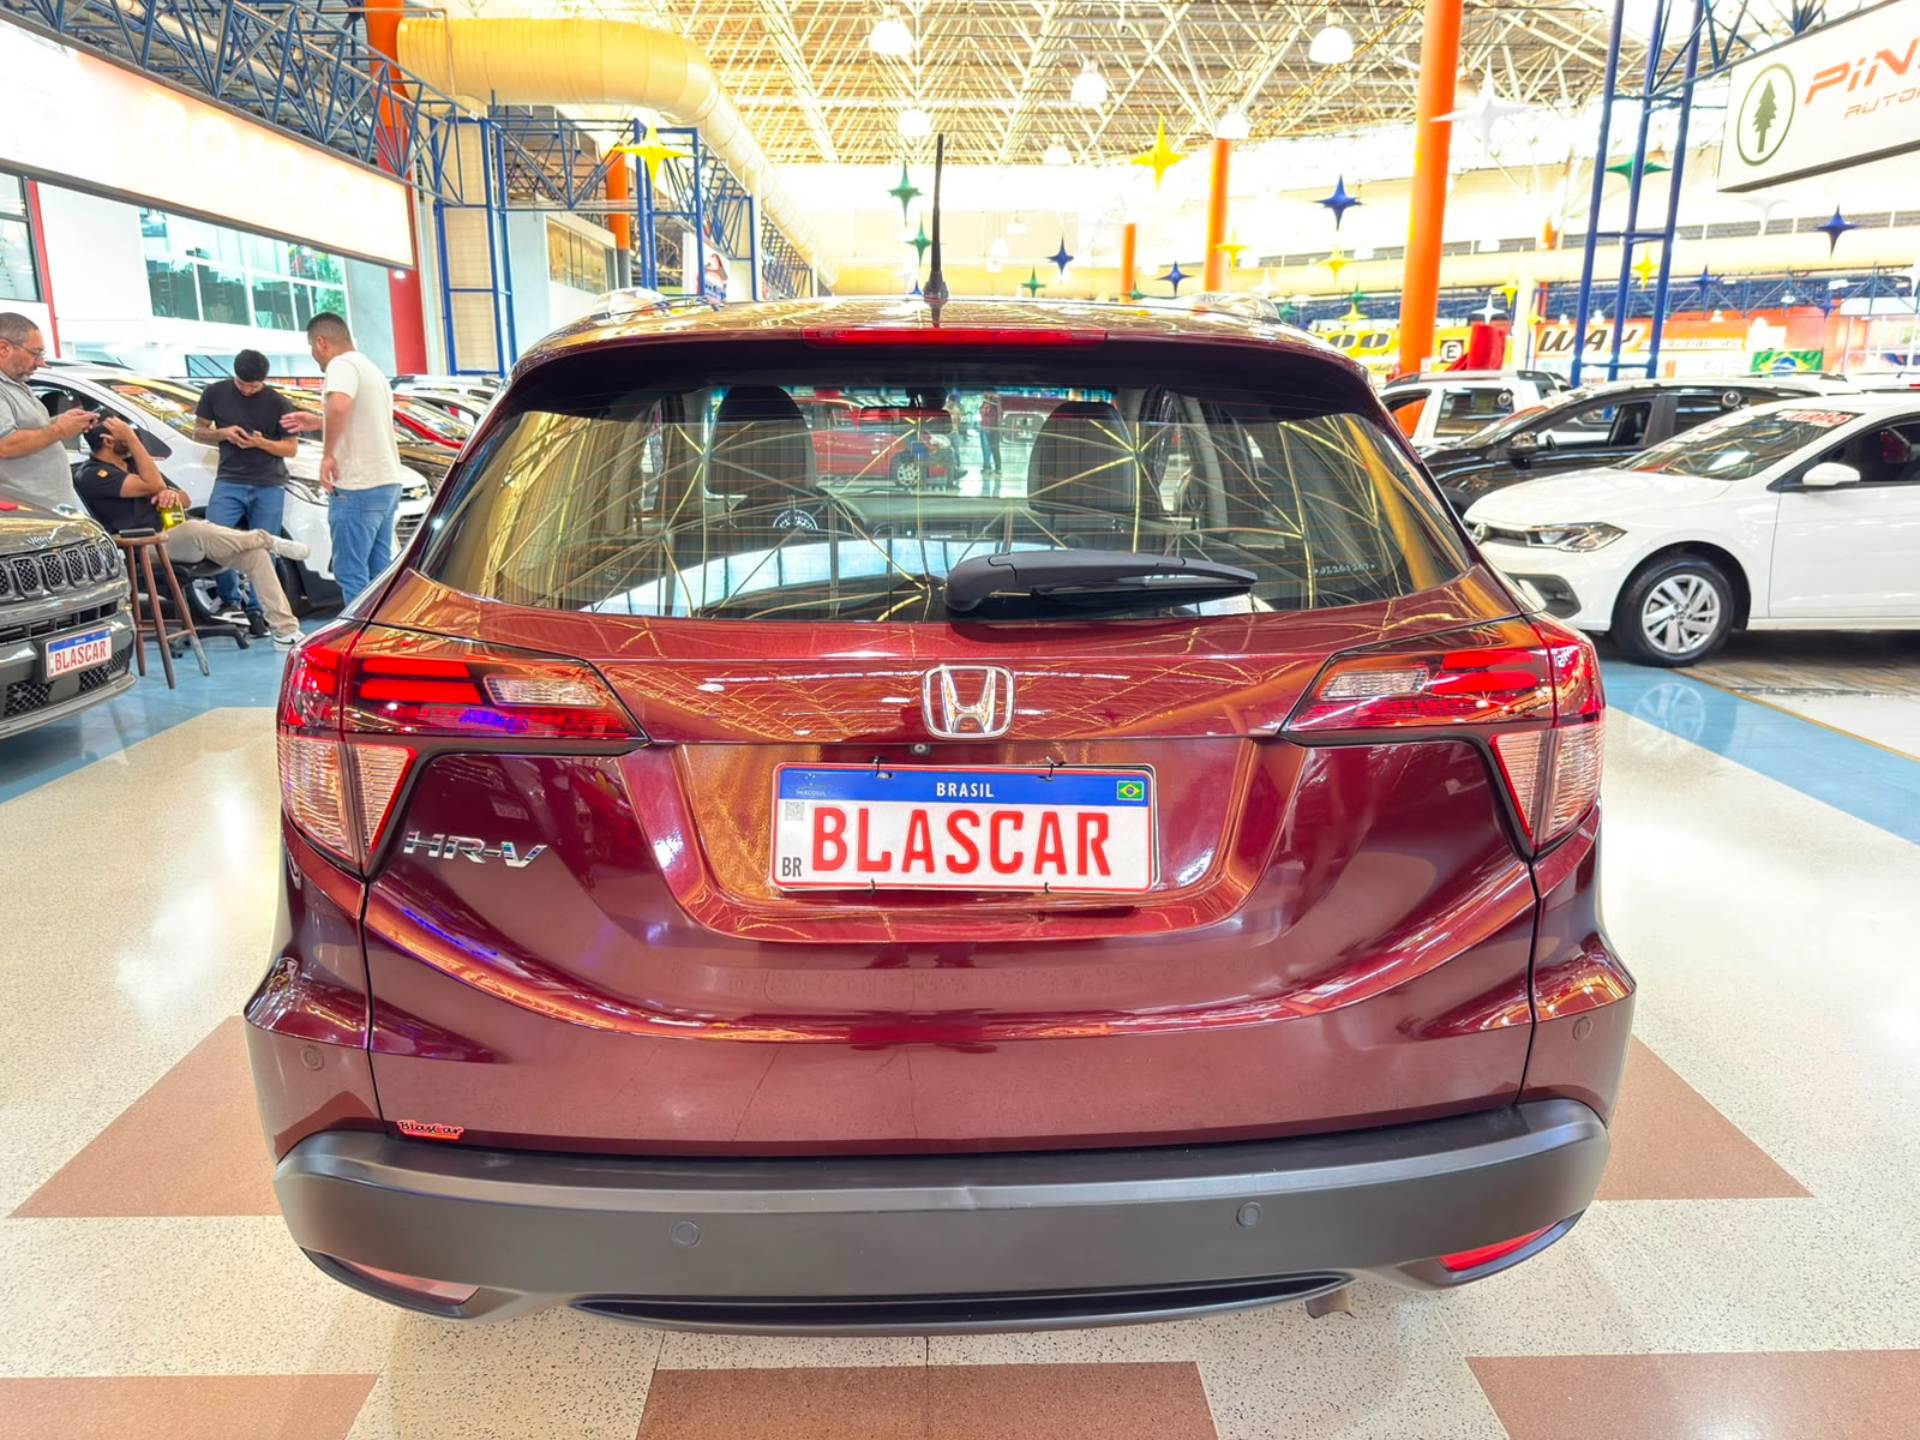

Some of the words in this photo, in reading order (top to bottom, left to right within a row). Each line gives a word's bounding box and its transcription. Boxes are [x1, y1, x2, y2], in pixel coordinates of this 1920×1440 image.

[54, 641, 107, 671] BLASCAR
[936, 781, 994, 798] BRASIL
[404, 831, 548, 868] HR-V
[812, 807, 1111, 876] BLASCAR
[782, 857, 802, 877] BR
